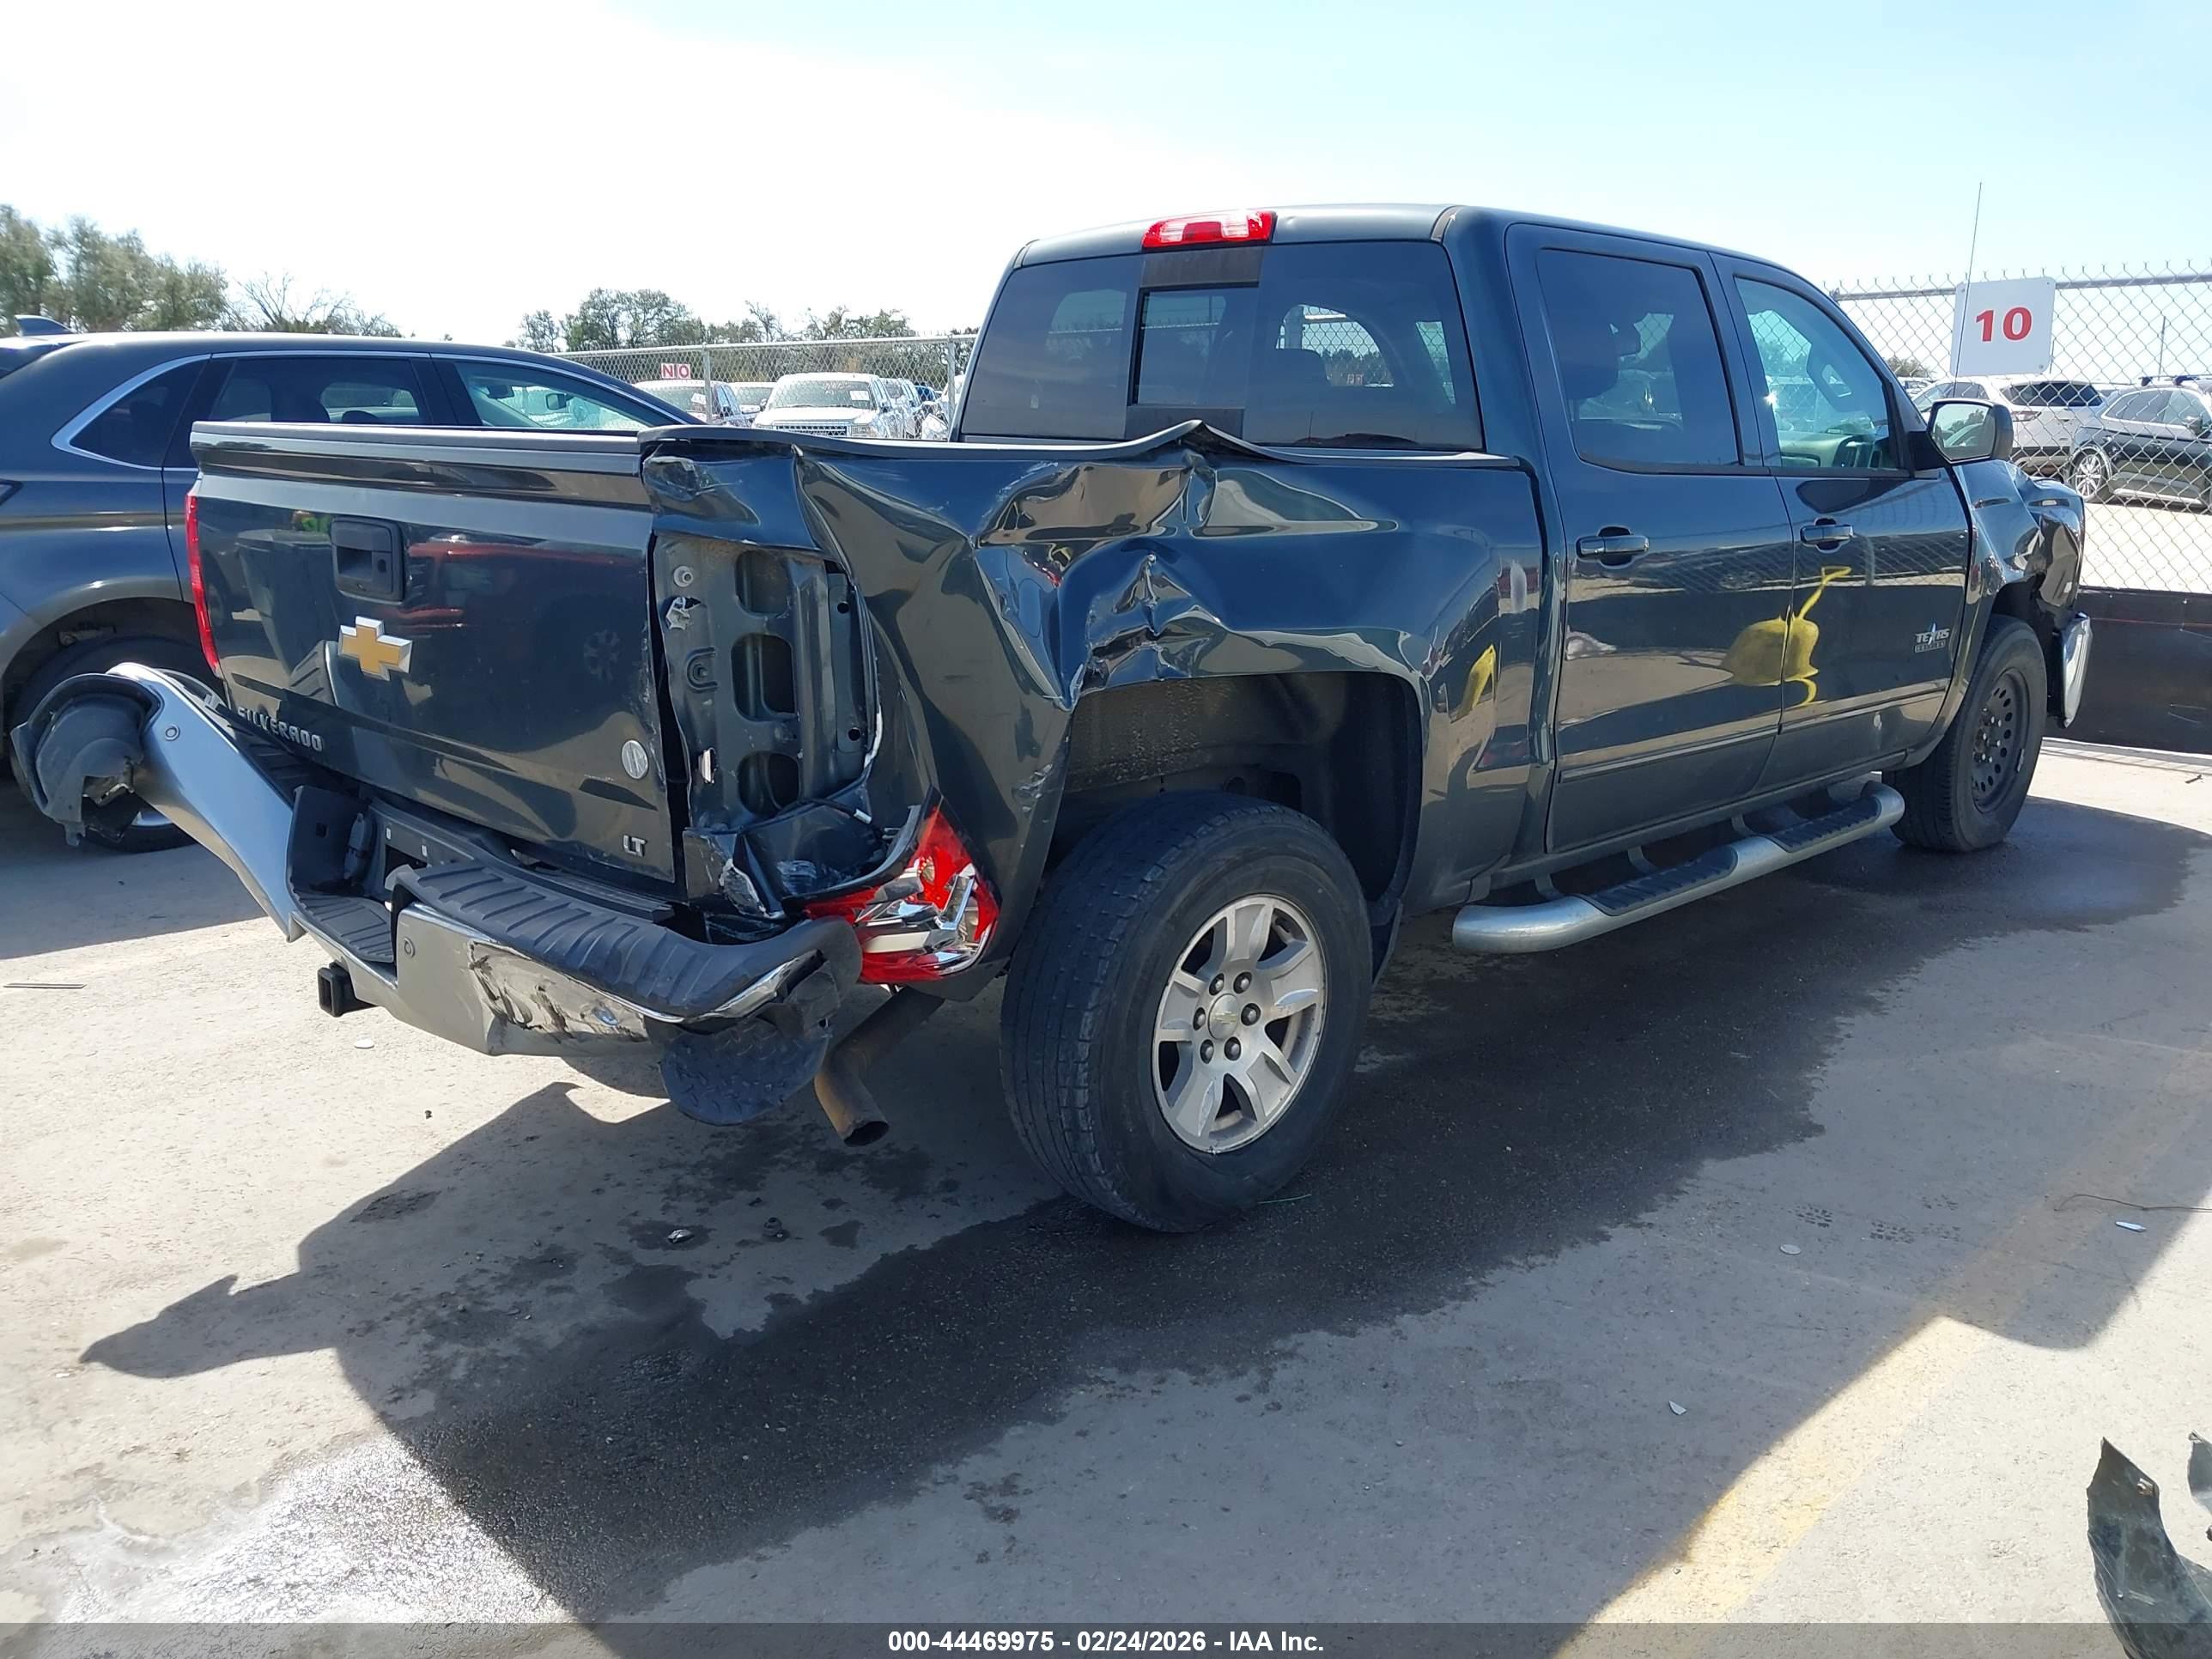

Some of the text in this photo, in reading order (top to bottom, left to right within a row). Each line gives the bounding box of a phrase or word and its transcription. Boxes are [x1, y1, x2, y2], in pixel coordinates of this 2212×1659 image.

[1975, 307, 2033, 342] 10
[662, 364, 690, 378] NO
[1915, 627, 1950, 644] TEXAS
[237, 706, 323, 751] SILVERADO
[623, 834, 646, 857] LT
